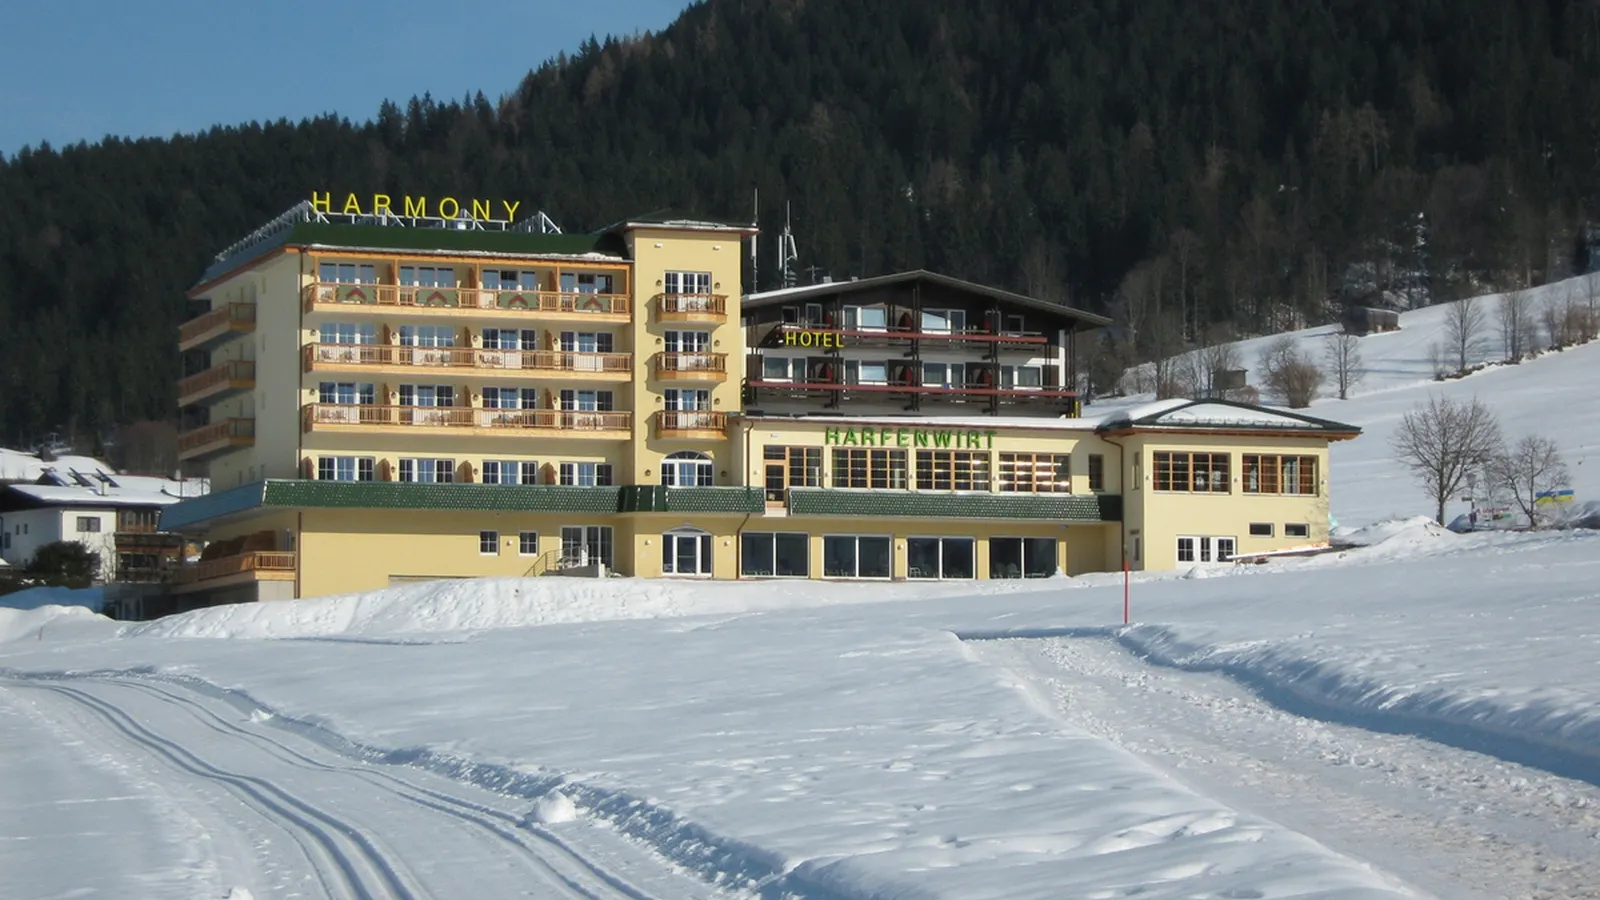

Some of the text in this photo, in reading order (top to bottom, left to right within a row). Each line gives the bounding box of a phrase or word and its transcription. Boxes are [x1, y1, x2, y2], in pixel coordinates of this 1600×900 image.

[312, 191, 520, 222] HARMONY
[785, 331, 844, 348] HOTEL
[825, 427, 997, 448] HARFENWIRT
